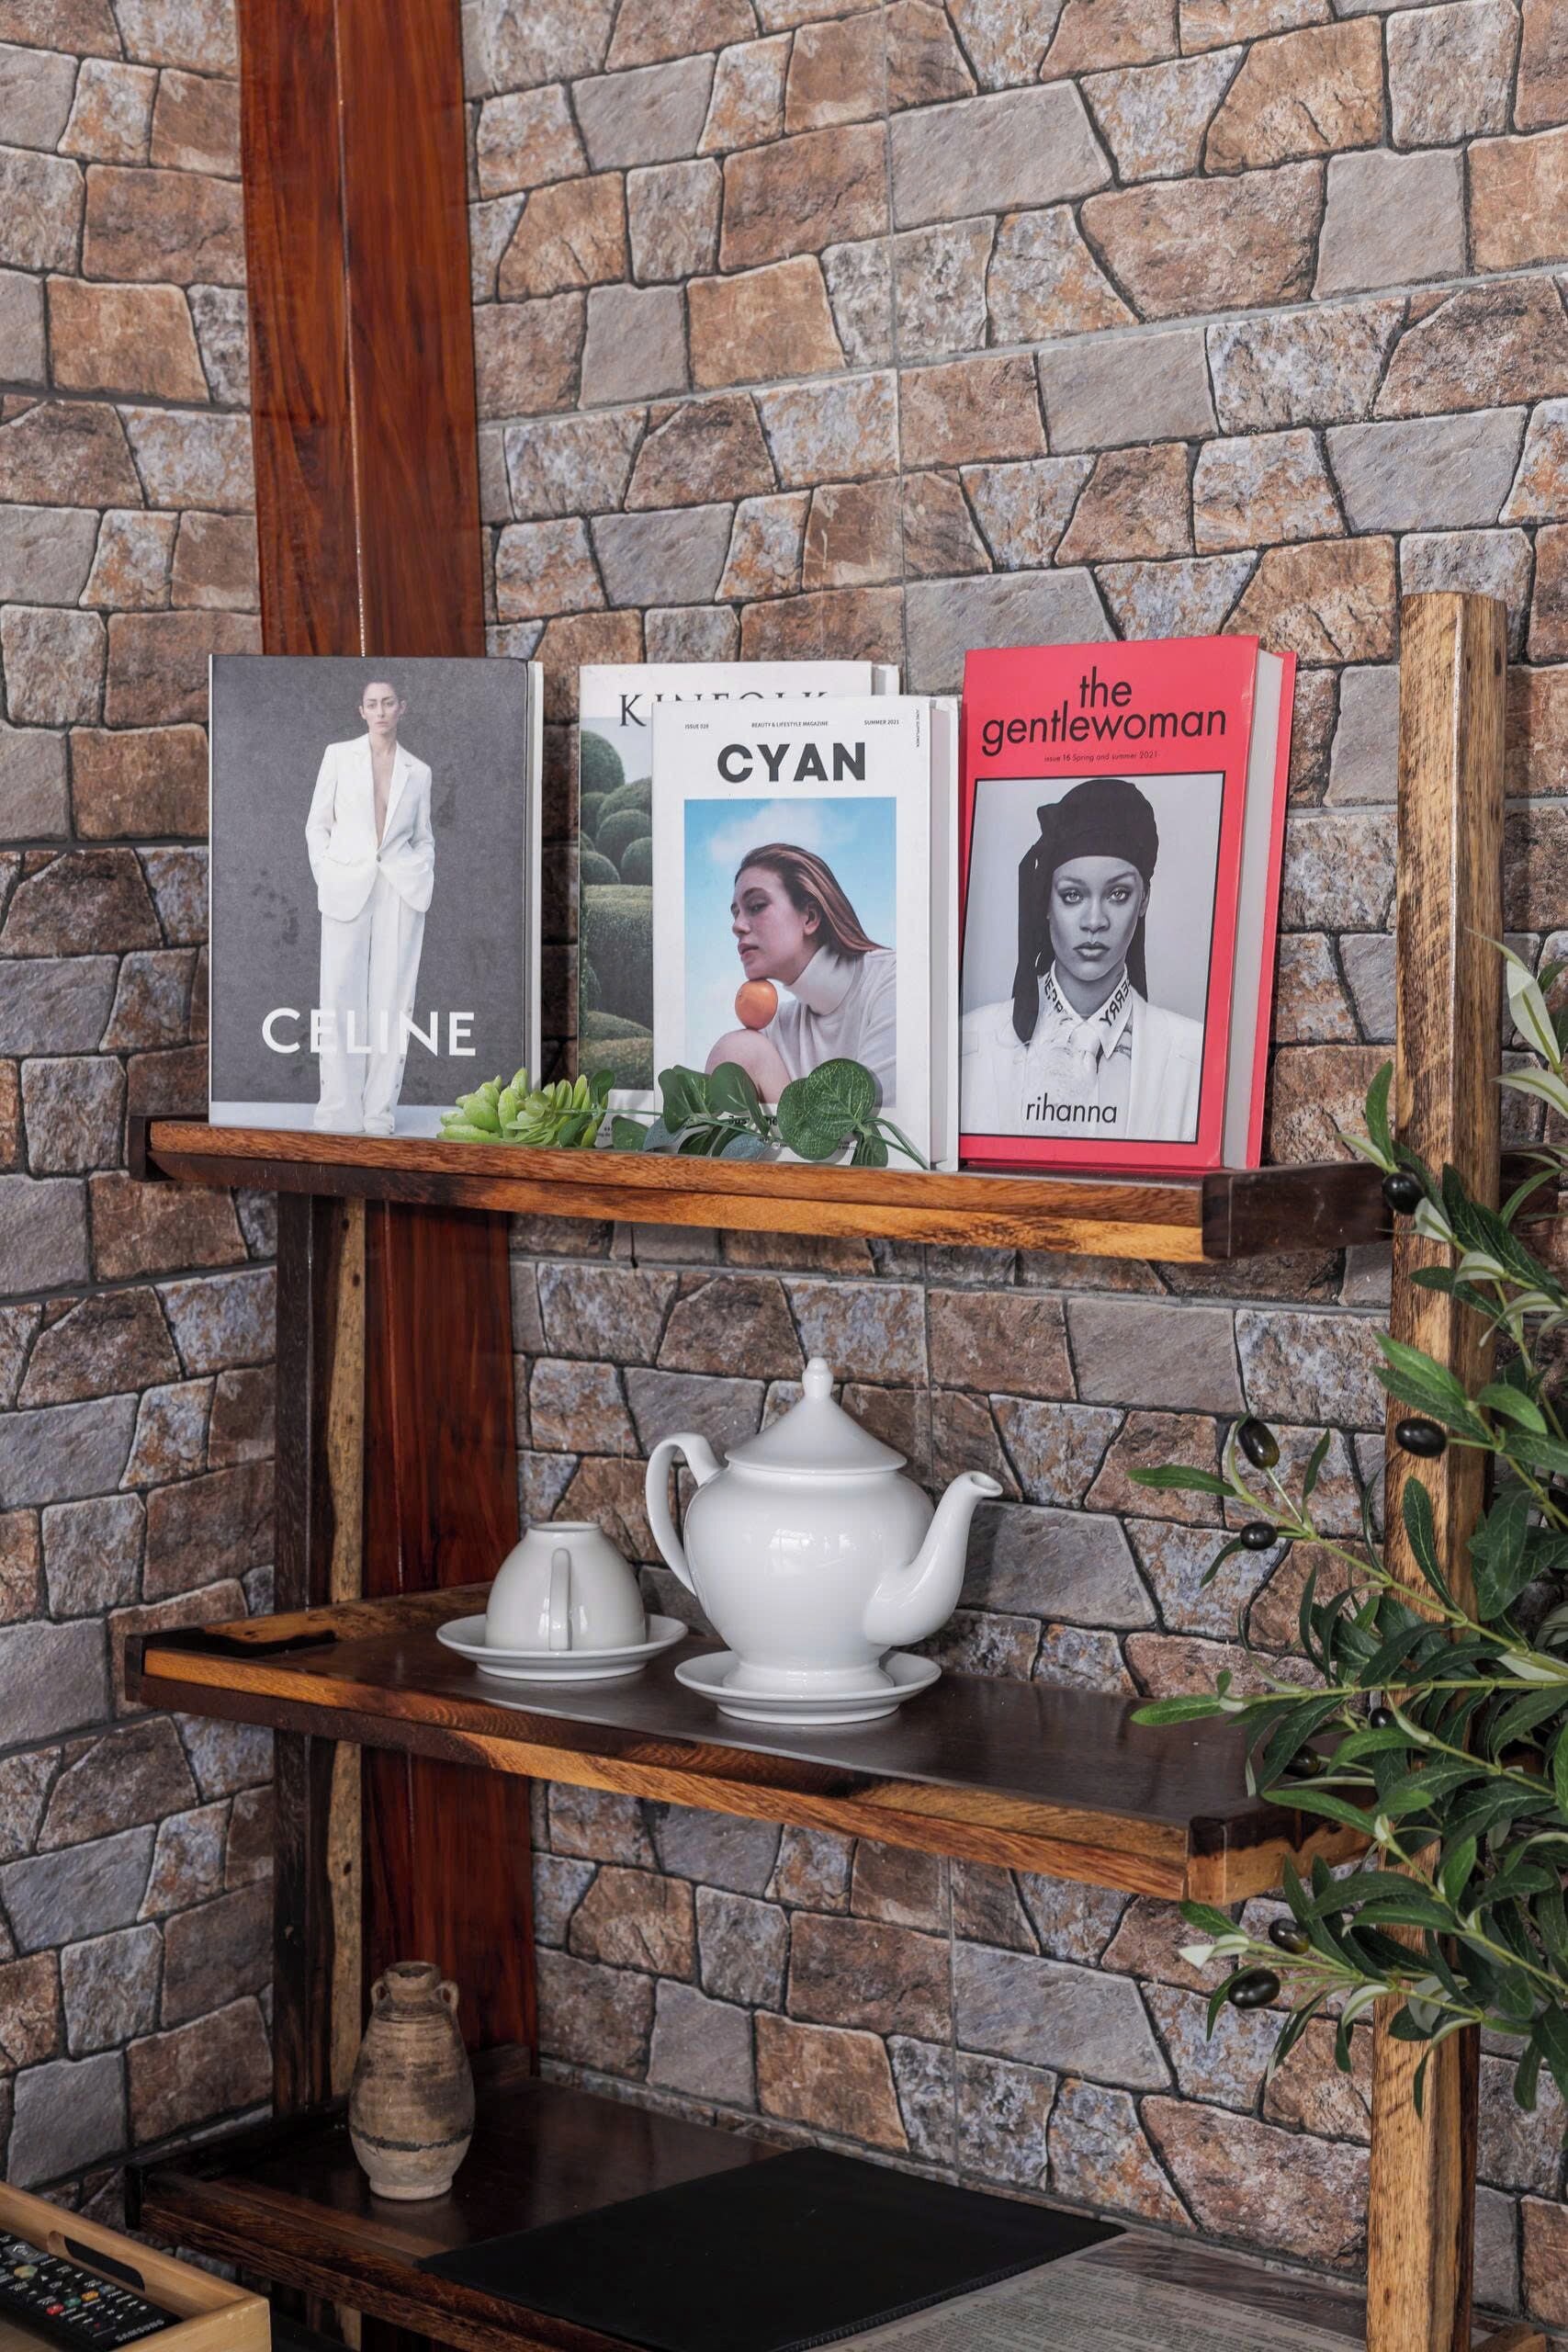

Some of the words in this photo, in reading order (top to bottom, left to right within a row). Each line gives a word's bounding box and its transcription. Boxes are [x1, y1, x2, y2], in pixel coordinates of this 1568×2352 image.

[1079, 666, 1133, 707] the
[981, 701, 1226, 757] gentlewoman
[716, 741, 866, 784] CYAN
[1138, 751, 1157, 759] 2021
[262, 1008, 477, 1057] CELINE
[1025, 1092, 1118, 1124] rihanna
